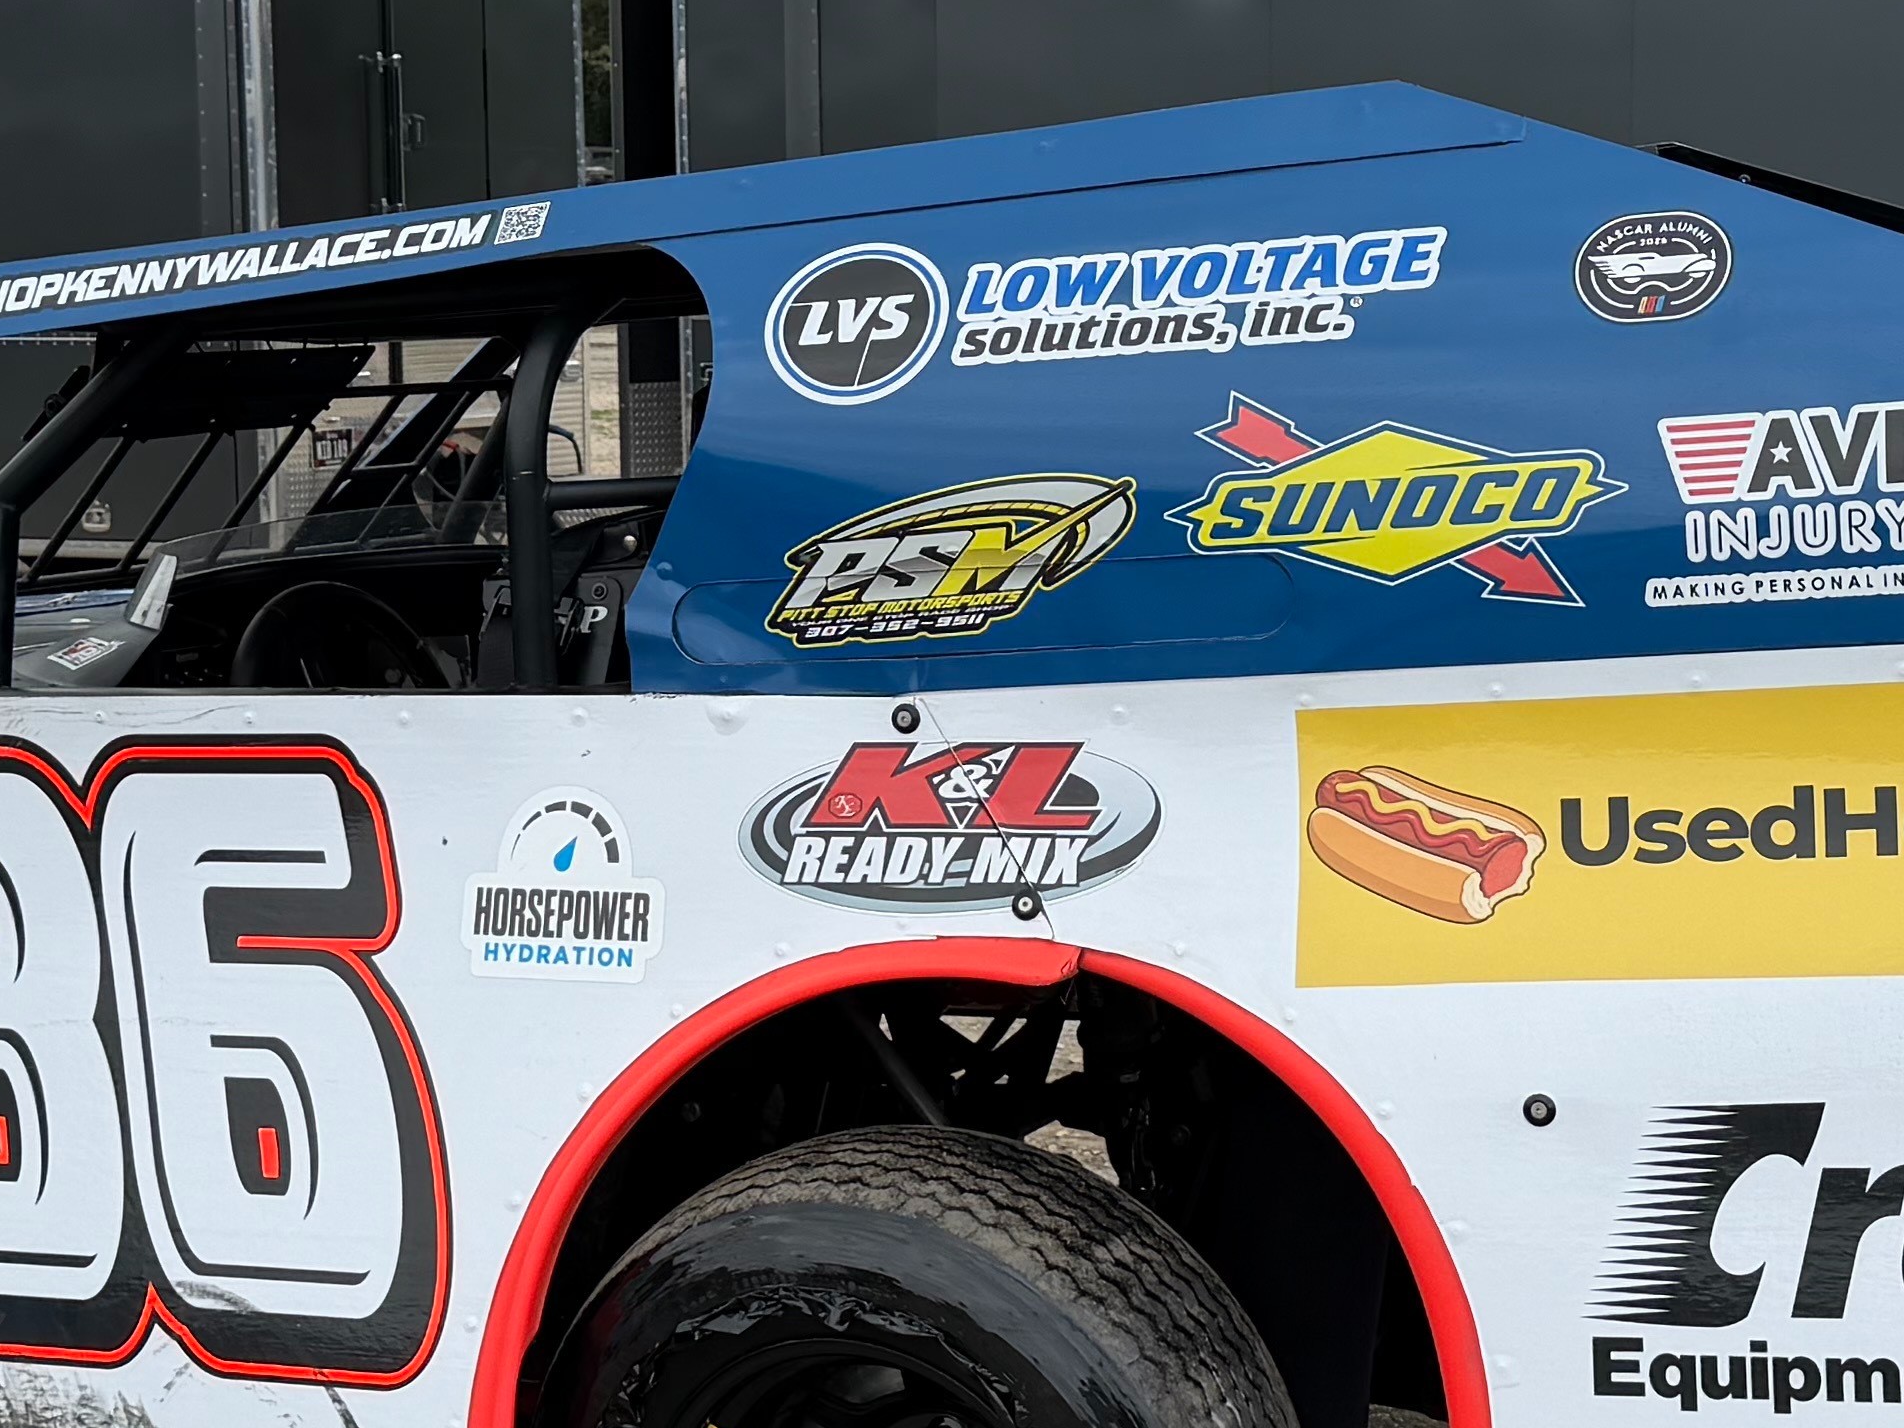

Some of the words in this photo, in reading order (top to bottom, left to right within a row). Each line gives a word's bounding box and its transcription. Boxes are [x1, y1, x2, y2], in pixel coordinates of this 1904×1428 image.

[1596, 223, 1653, 253] NASCAR
[1659, 221, 1713, 245] ALUMNI
[964, 259, 1120, 316] LOW
[1138, 235, 1438, 307] VOLTAGE
[793, 293, 914, 347] LVS
[959, 307, 1228, 360] solutions,
[1209, 466, 1582, 540] SUNOCO
[786, 525, 1058, 610] PSM
[1652, 579, 1746, 601] MAKING
[1754, 573, 1875, 595] PERSONAL
[778, 603, 823, 622] PITT
[824, 600, 879, 619] STOP
[881, 590, 1022, 615] MOTORSPORTS
[800, 742, 1099, 829] K&L
[782, 835, 1088, 885] READY-MIX
[473, 885, 649, 943] HORSEPOWER
[482, 942, 635, 968] HYDRATION
